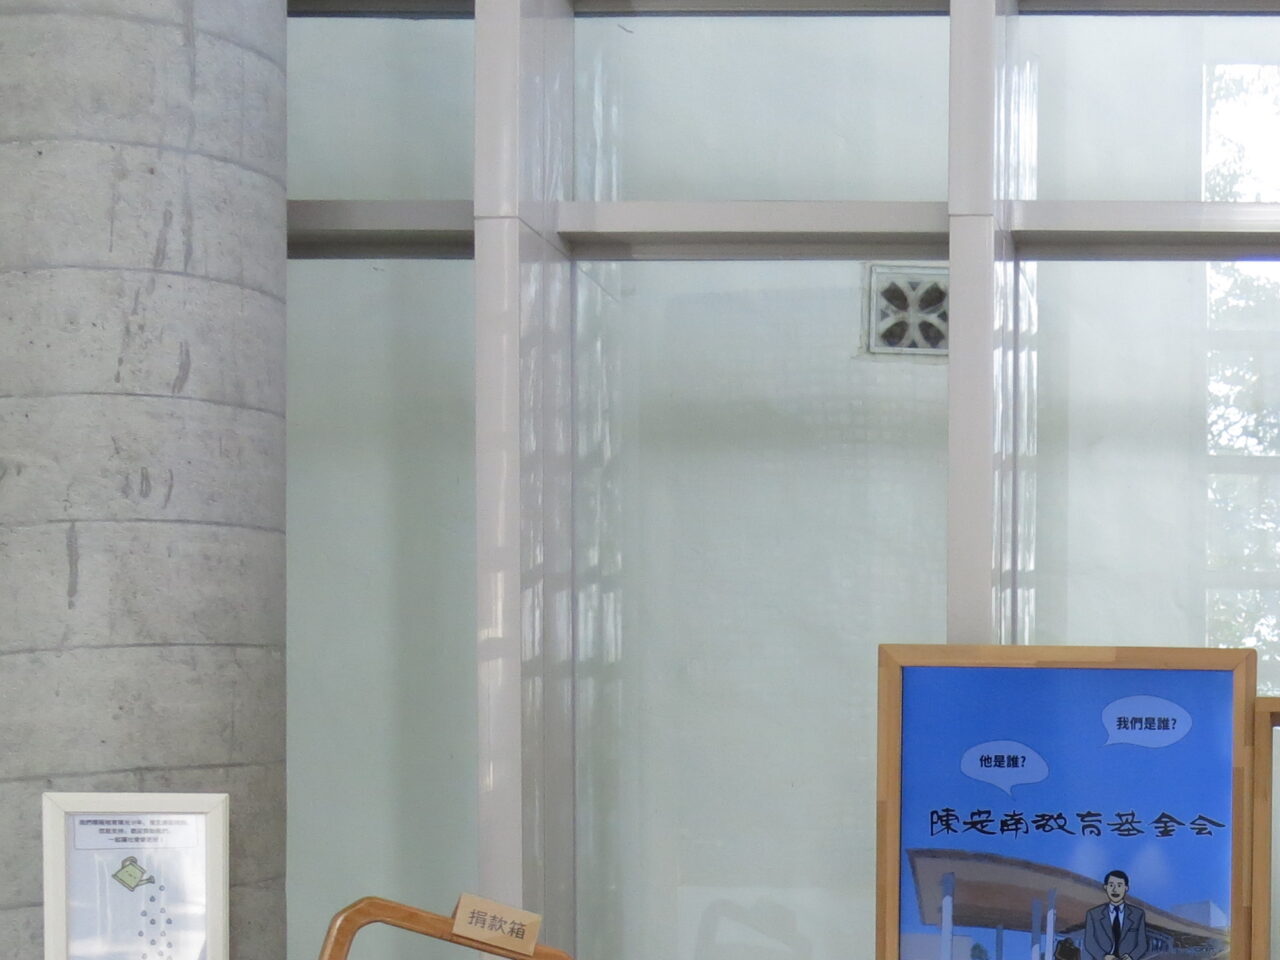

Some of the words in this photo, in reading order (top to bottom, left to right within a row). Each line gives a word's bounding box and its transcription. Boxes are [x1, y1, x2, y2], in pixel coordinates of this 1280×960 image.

[1116, 716, 1177, 731] 我們是誰?
[979, 754, 1026, 769] 他是誰?
[468, 909, 527, 940] 捐款箱
